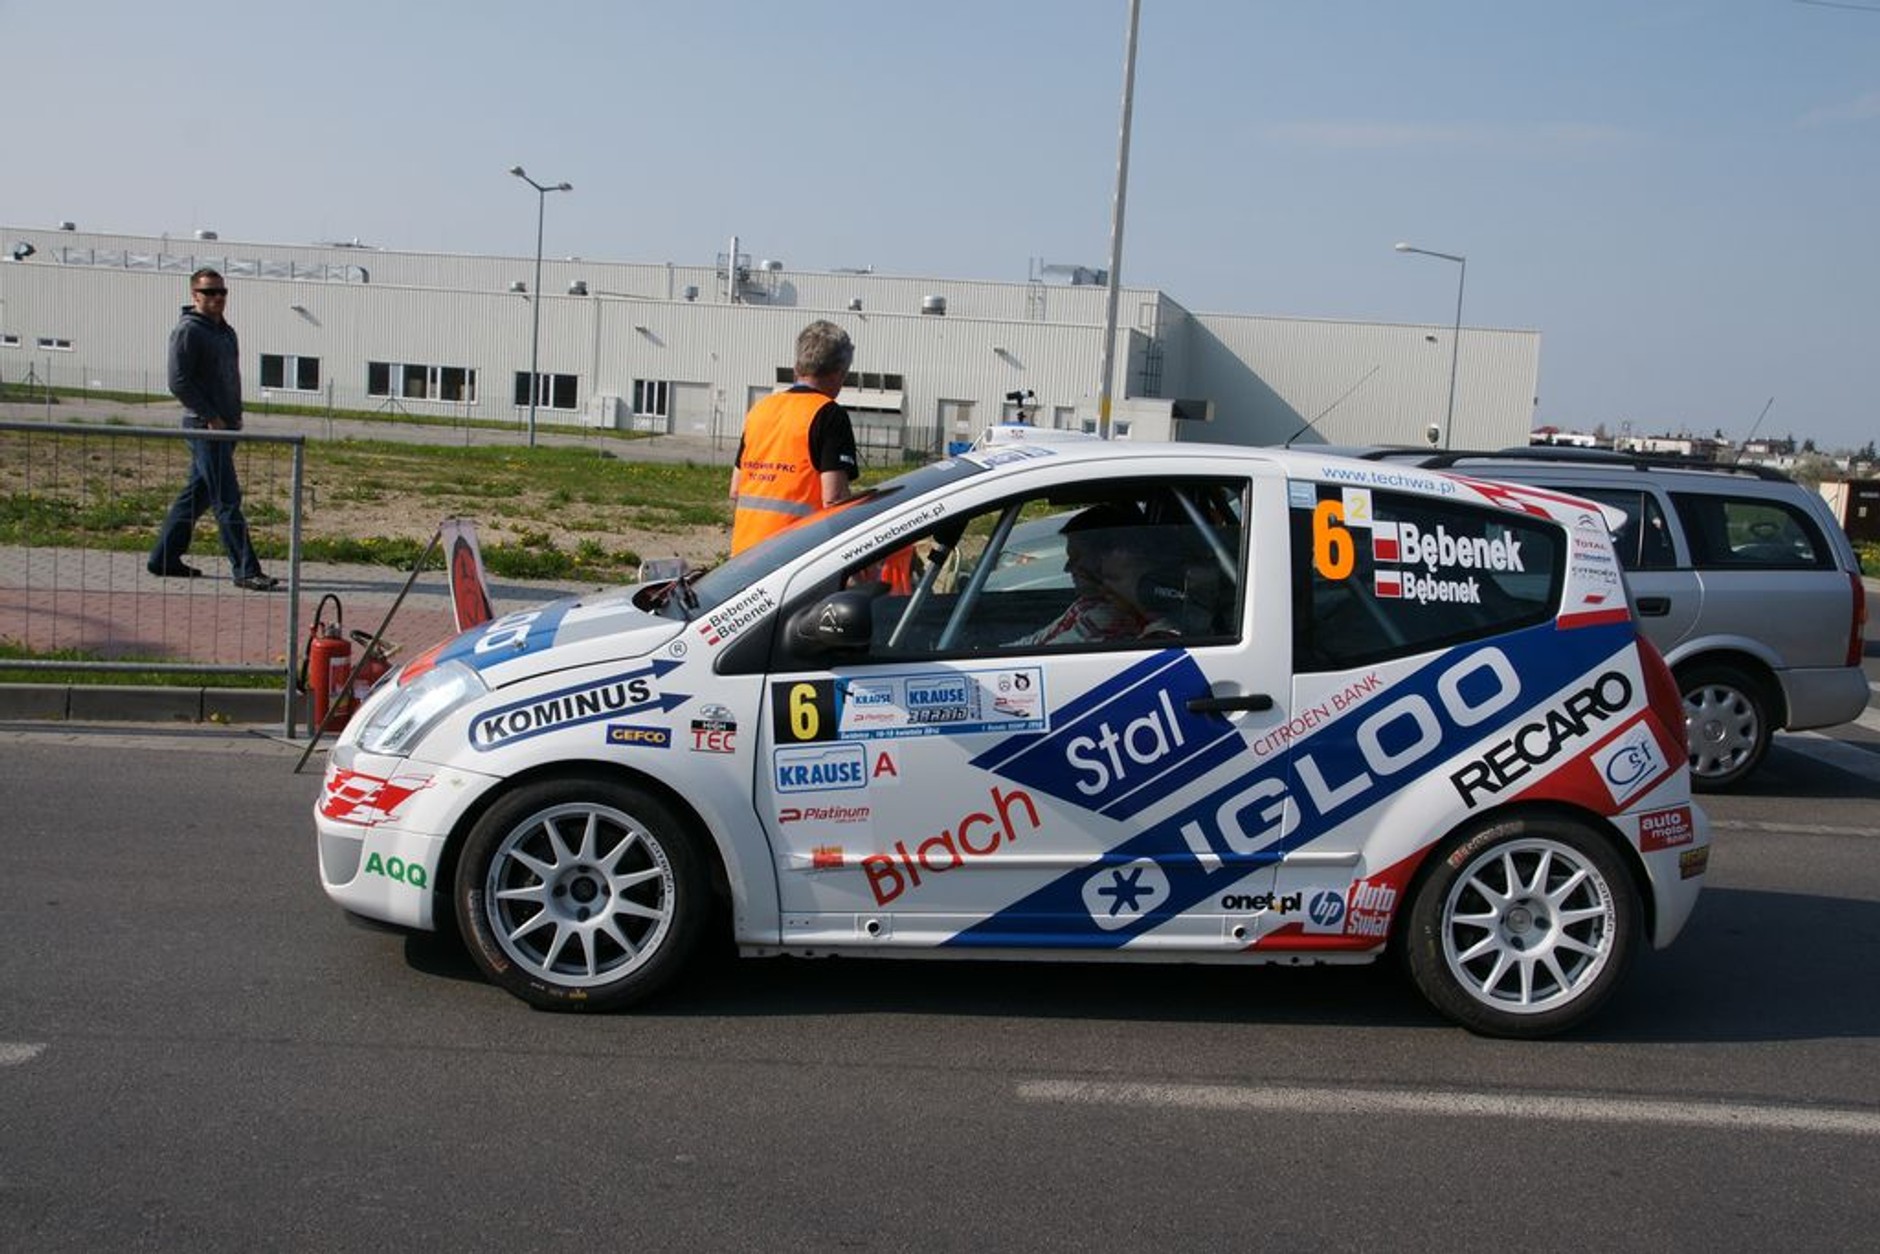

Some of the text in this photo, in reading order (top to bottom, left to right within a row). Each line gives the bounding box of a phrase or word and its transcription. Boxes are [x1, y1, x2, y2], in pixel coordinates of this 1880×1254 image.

[1322, 466, 1456, 495] www.techwa.pl
[1351, 495, 1368, 519] 2
[1313, 499, 1355, 580] 6
[1399, 521, 1525, 573] Bębenek
[1402, 571, 1481, 605] Bębenek
[909, 687, 964, 705] KRAUSE
[1331, 672, 1383, 711] BANK
[484, 679, 651, 742] KOMINUS
[789, 683, 820, 740] 6
[612, 728, 666, 743] GEFCO
[692, 730, 736, 750] TEC
[1066, 688, 1185, 795] Stal
[1450, 671, 1633, 809] RECARO
[779, 762, 862, 787] KRAUSE
[873, 751, 897, 778] A
[1180, 646, 1521, 875] IGLOO
[803, 806, 870, 820] Platinum
[1642, 813, 1682, 830] auto
[861, 786, 1041, 907] Blach
[1652, 824, 1689, 838] motor
[365, 852, 428, 889] AQQ
[1221, 892, 1302, 915] onet.pl
[1312, 890, 1341, 927] hp
[1351, 880, 1397, 912] Auto
